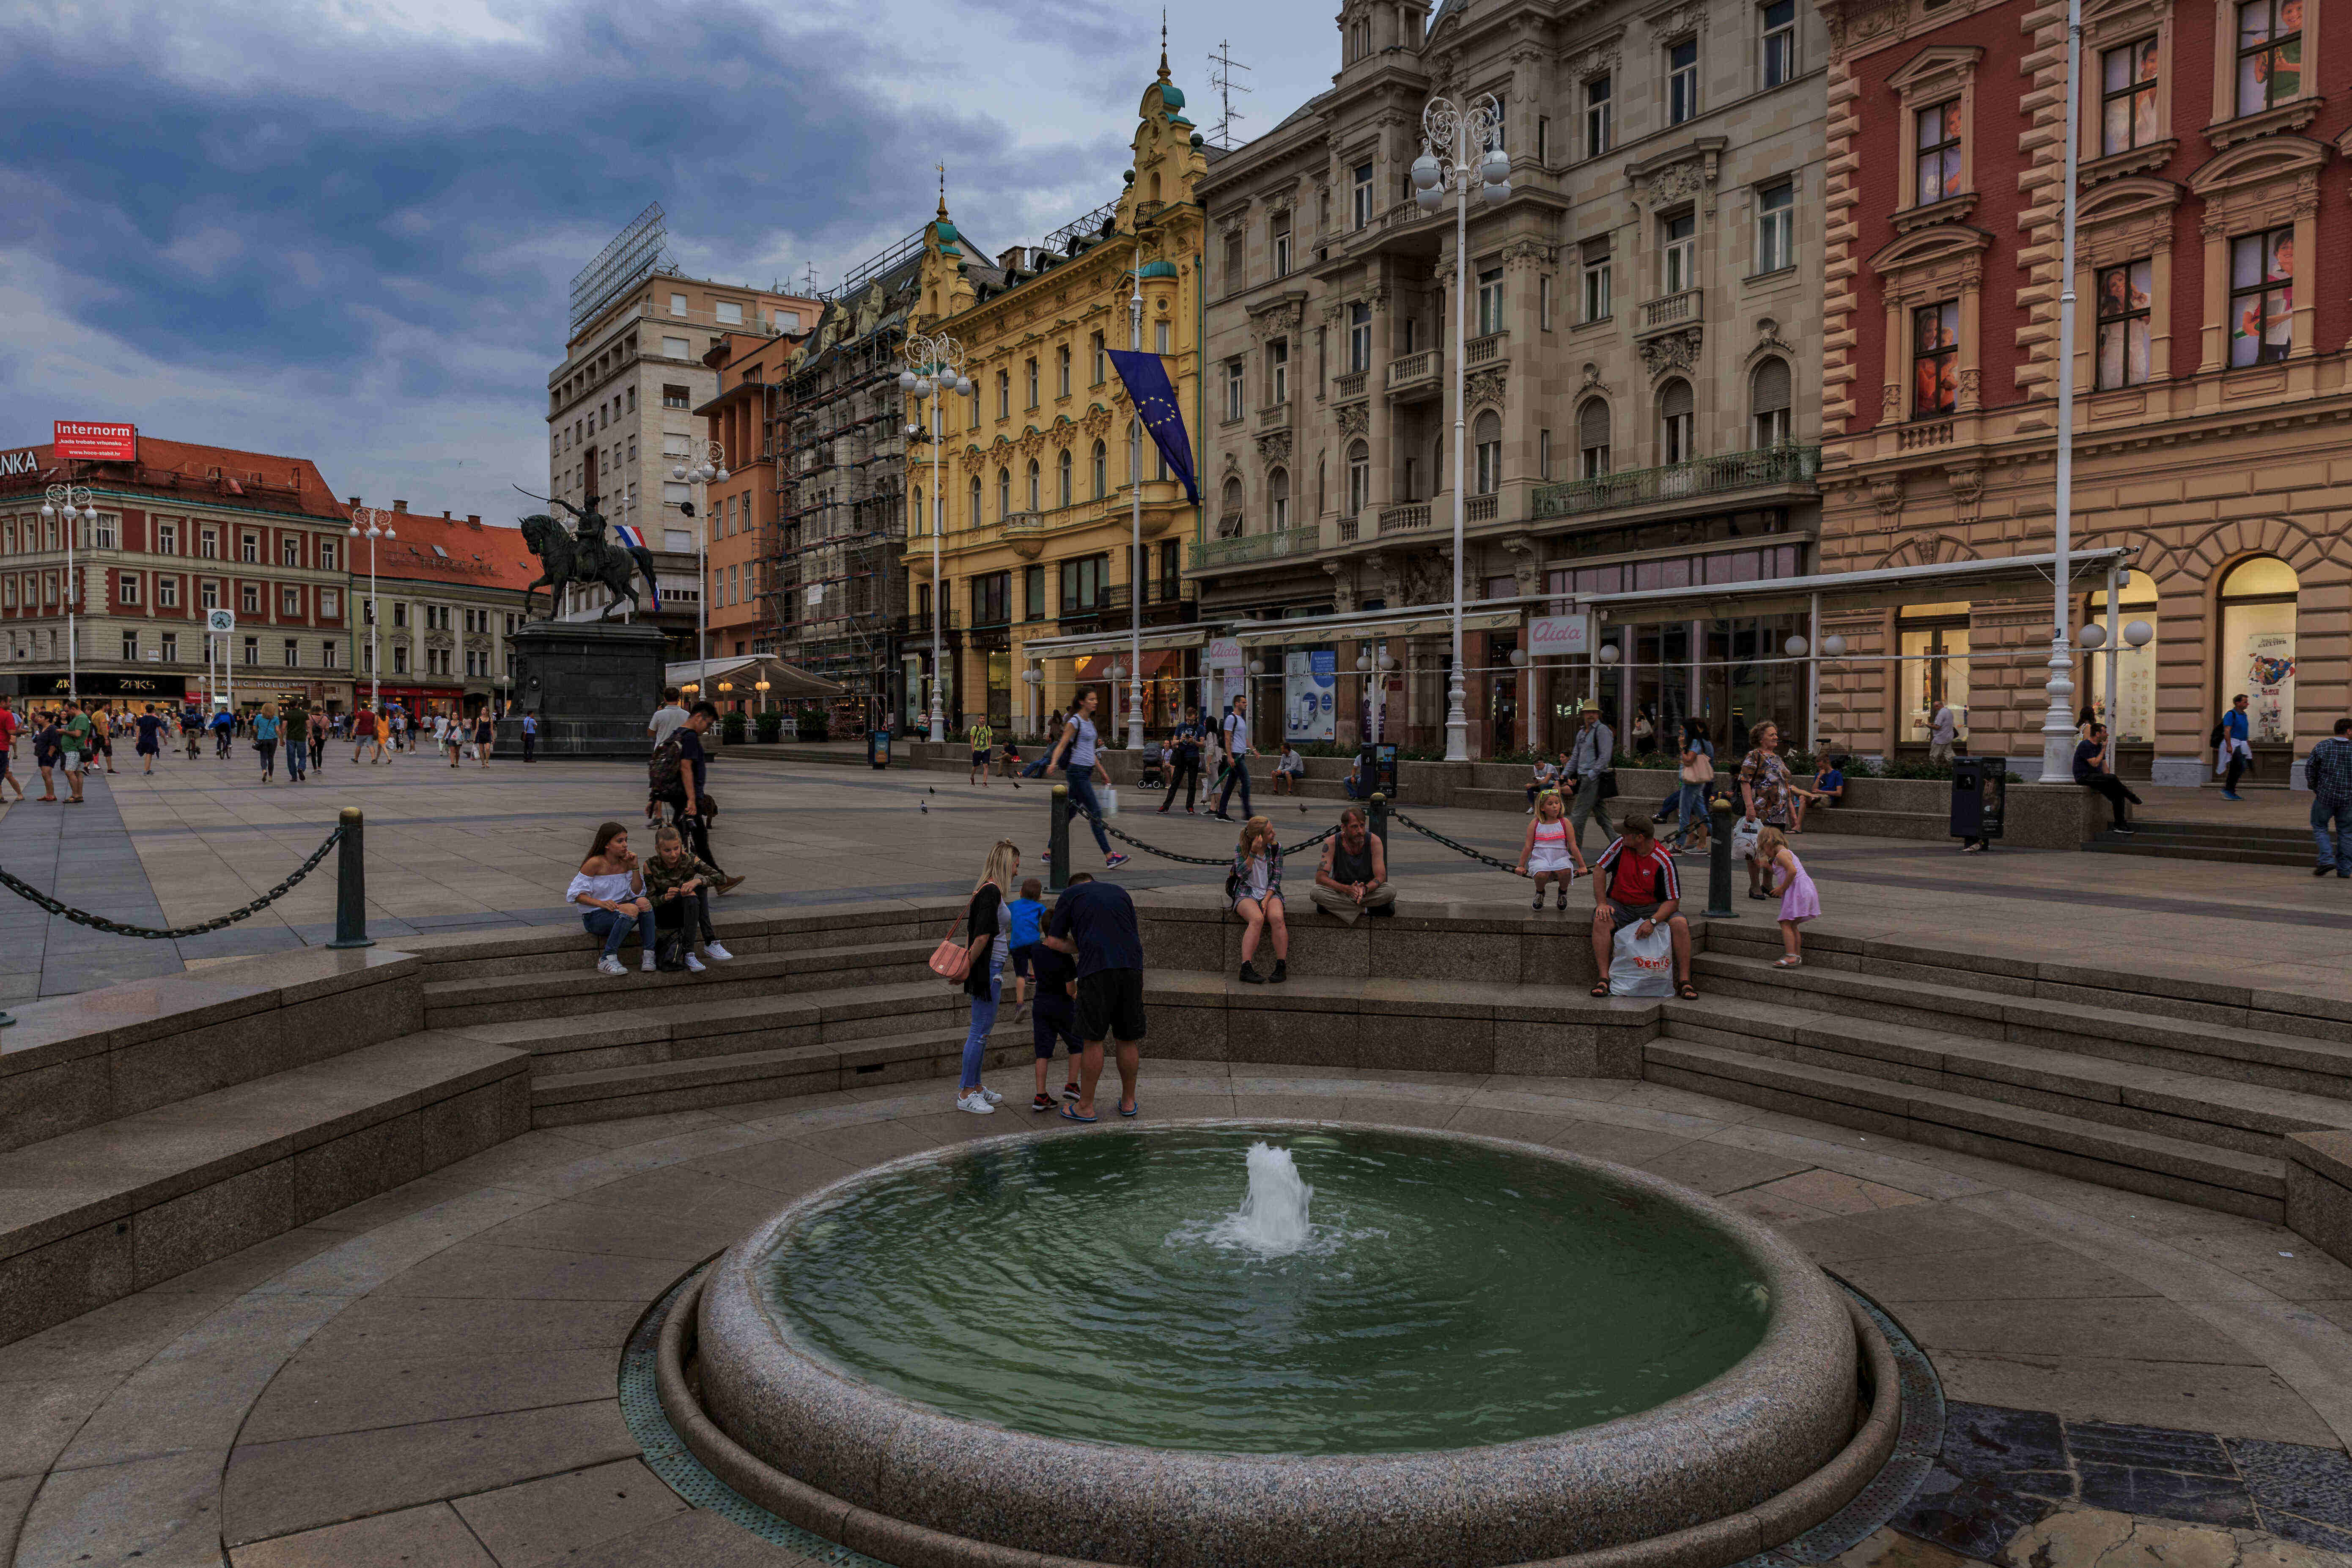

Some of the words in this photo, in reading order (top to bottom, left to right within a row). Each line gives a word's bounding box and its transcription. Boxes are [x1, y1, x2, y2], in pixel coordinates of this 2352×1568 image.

[58, 423, 130, 437] Internorm
[0, 451, 37, 476] NKA
[1633, 956, 1669, 968] Denis
